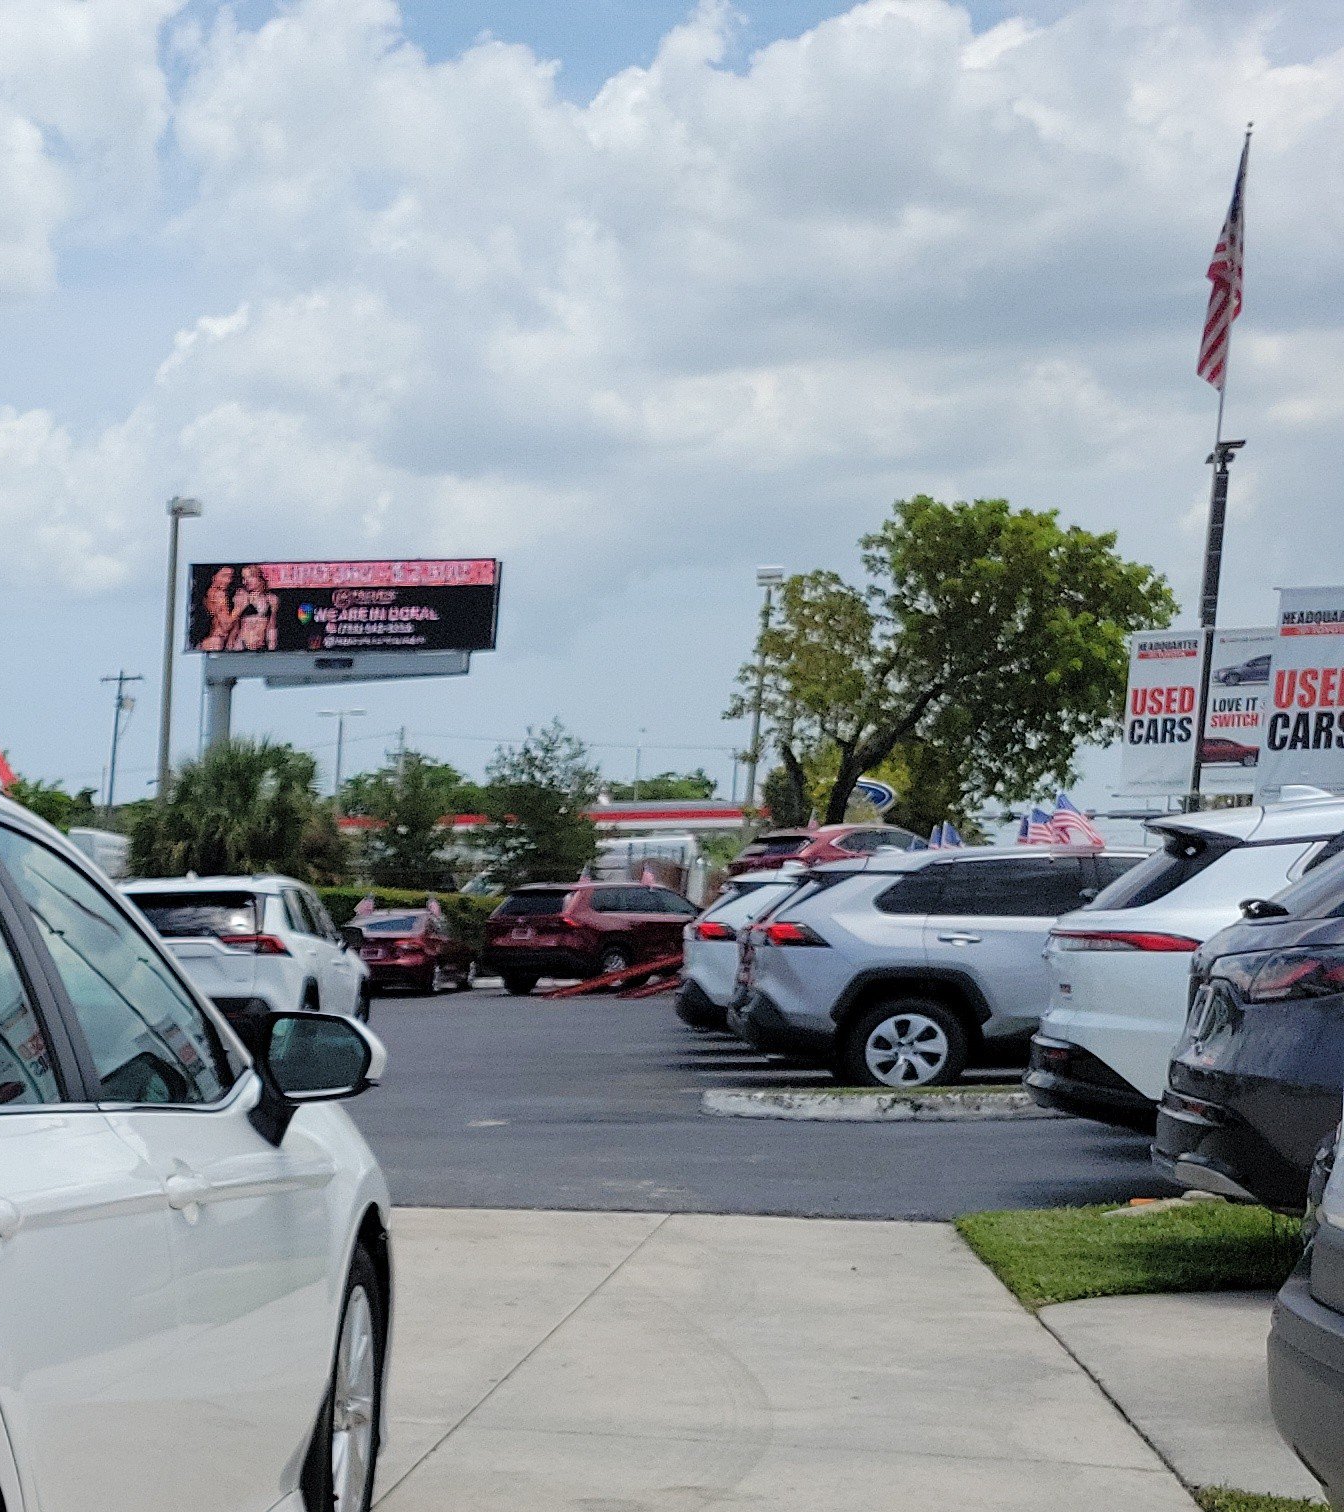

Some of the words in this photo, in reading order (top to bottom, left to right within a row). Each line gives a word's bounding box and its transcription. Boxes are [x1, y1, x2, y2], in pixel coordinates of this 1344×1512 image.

[1131, 686, 1195, 717] USED
[1212, 697, 1242, 713] LOVE
[1245, 697, 1258, 711] IT
[1129, 716, 1192, 745] CARS
[1210, 713, 1259, 728] SWITCH
